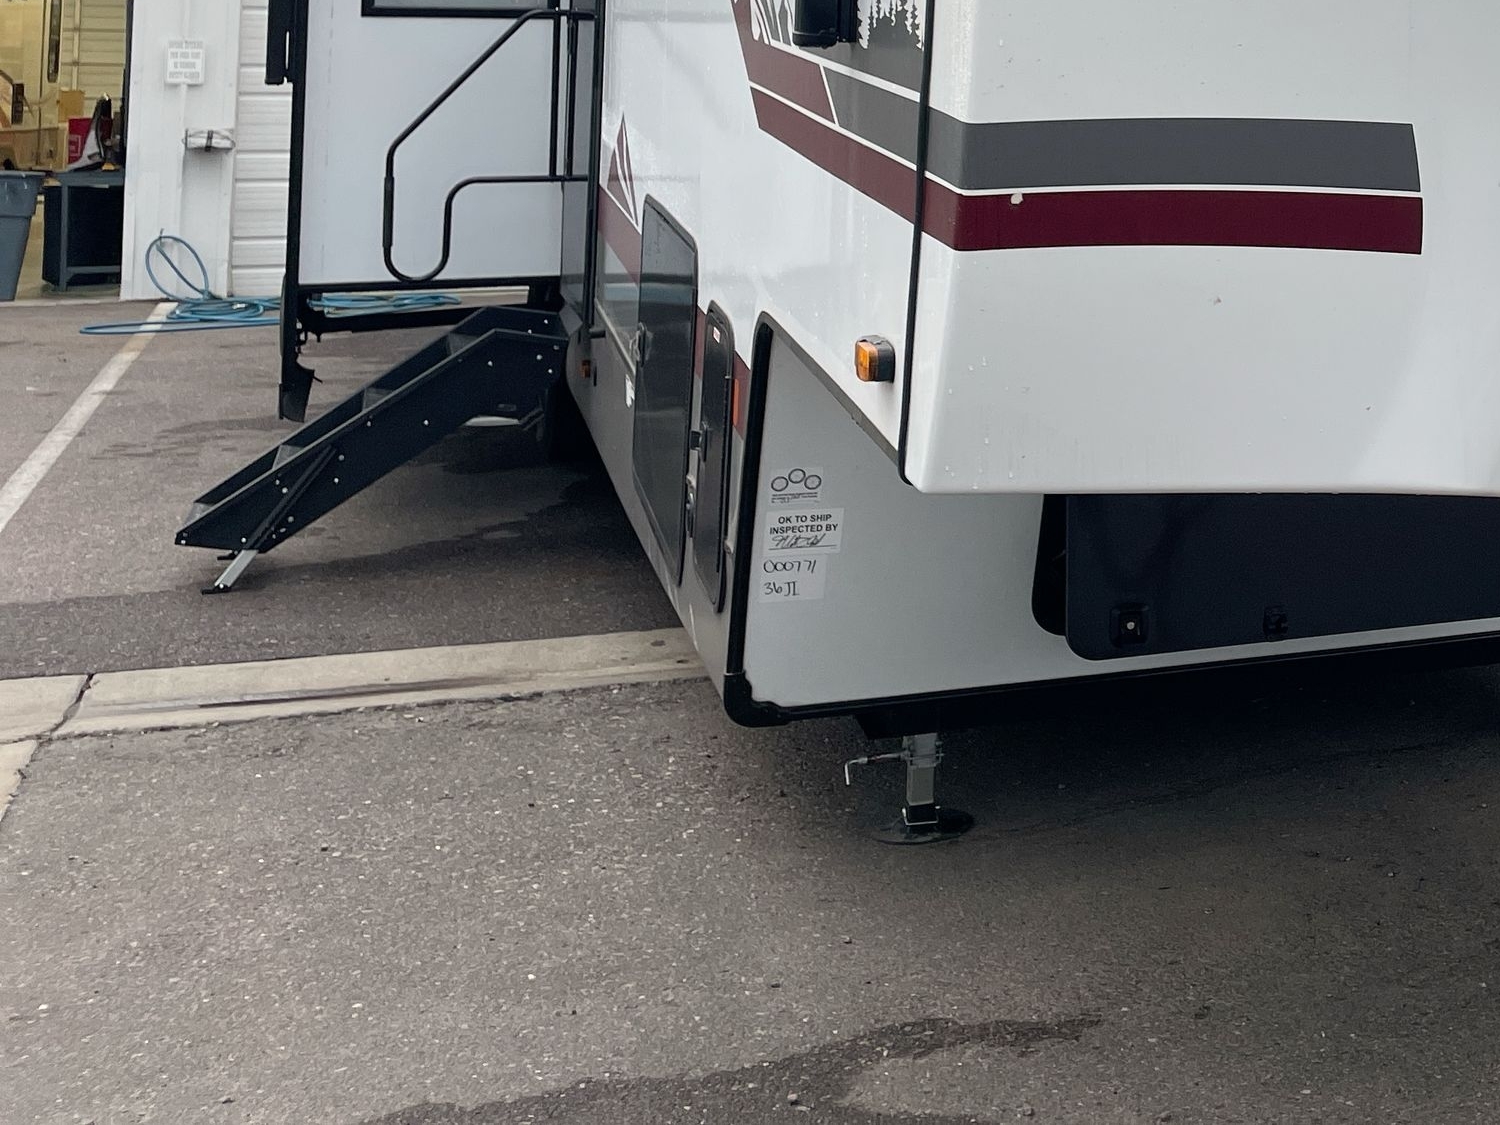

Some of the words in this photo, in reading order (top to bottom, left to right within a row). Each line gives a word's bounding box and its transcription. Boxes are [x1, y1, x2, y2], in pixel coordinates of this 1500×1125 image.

[778, 515, 792, 524] OK
[795, 515, 808, 523] TO
[810, 513, 832, 522] SHIP
[769, 524, 823, 535] INSPECTED
[825, 523, 839, 532] BY
